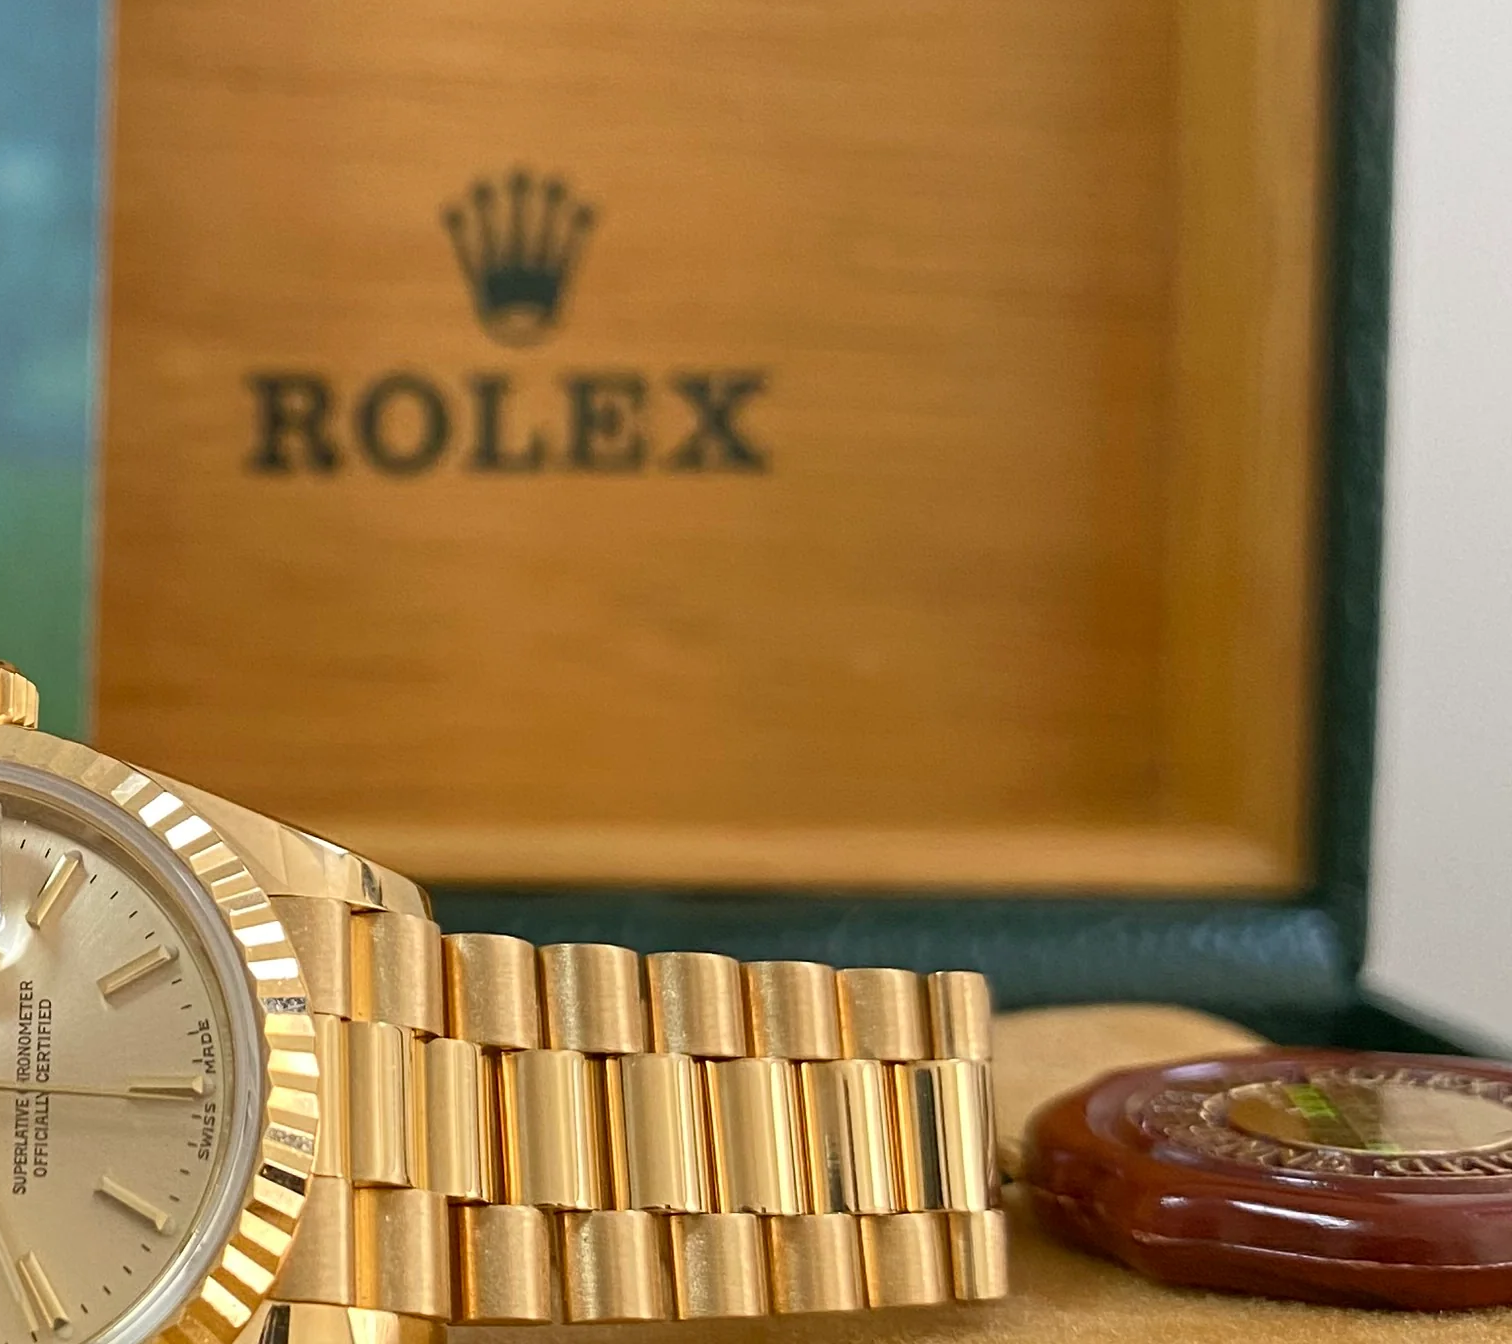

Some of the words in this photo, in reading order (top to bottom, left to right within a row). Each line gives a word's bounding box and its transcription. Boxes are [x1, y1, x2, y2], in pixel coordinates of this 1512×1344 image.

[243, 370, 770, 480] ROLEX
[36, 998, 52, 1084] CERTIFIED
[198, 1018, 216, 1074] MADE
[13, 1098, 29, 1195] SUPERLATIVE
[198, 1103, 216, 1160] SWISS
